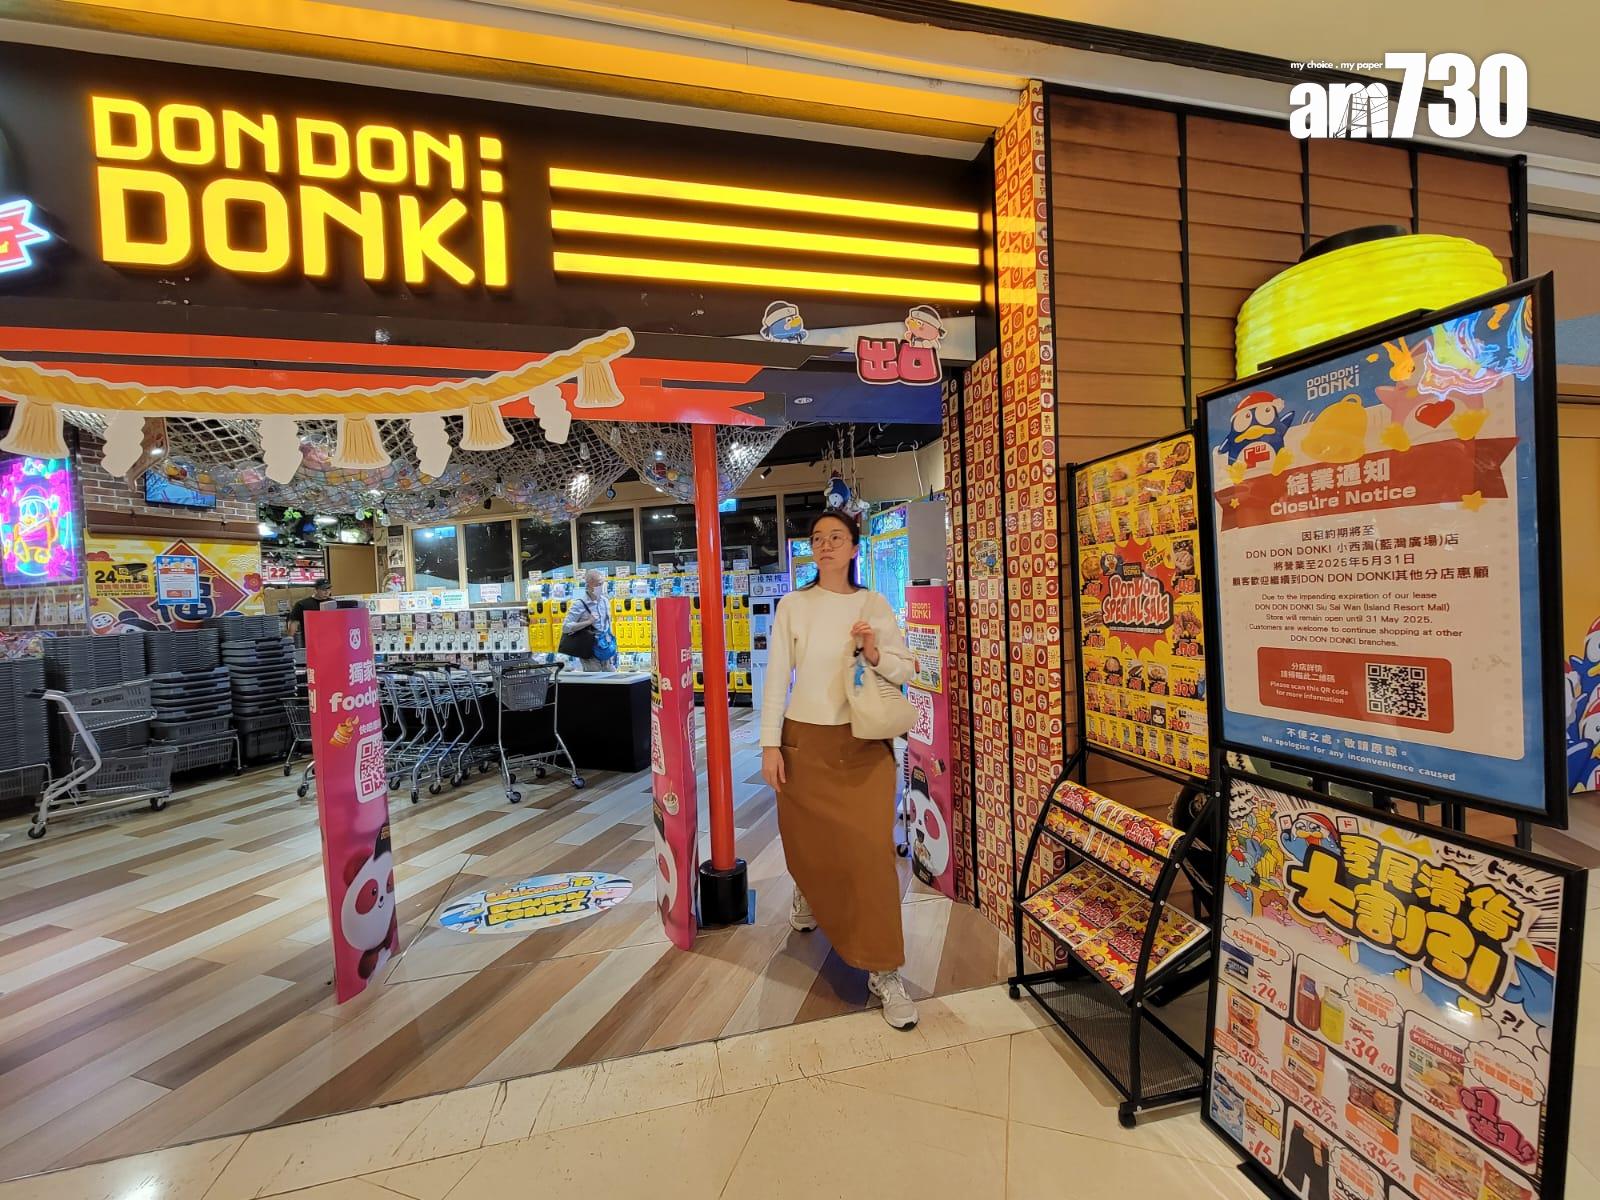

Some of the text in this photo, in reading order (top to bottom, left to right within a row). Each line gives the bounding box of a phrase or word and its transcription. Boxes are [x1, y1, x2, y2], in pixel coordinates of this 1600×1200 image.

[92, 96, 464, 190] DON DON
[858, 336, 942, 385] 出口
[1306, 366, 1354, 388] DON DON
[1286, 458, 1390, 495] 結業通知
[1270, 486, 1416, 516] Closure Notice
[1301, 525, 1374, 541] 因租約期將至
[1246, 551, 1267, 559] DON
[1270, 548, 1292, 557] DON
[1296, 545, 1331, 555] DONKI
[1273, 553, 1415, 571] 將營業至2025年5月31日
[95, 570, 117, 583] 24
[1327, 573, 1352, 583] DON
[1300, 592, 1336, 601] impending
[1339, 592, 1379, 600] expiration
[1413, 591, 1437, 599] lease
[1103, 593, 1170, 626] SPECIAL SALE
[1255, 602, 1450, 612] DON DON DONKI Siu Sai Wan (Island Resort Mall)
[1381, 615, 1399, 624] May
[1403, 615, 1433, 623] 2025.
[1249, 623, 1282, 631] Customers
[1342, 626, 1376, 634] continue
[1379, 627, 1420, 637] shopping
[1423, 628, 1432, 636] at
[1436, 628, 1463, 637] other
[1358, 638, 1399, 647] branches.
[1270, 681, 1290, 689] Please
[1307, 684, 1319, 692] this
[1320, 686, 1331, 694] QR
[1332, 688, 1349, 696] code
[1304, 692, 1344, 704] information
[1262, 735, 1272, 743] We
[1313, 745, 1325, 753] for
[1329, 750, 1344, 759] any
[1347, 753, 1414, 772] inconvenience
[1418, 767, 1457, 781] caused
